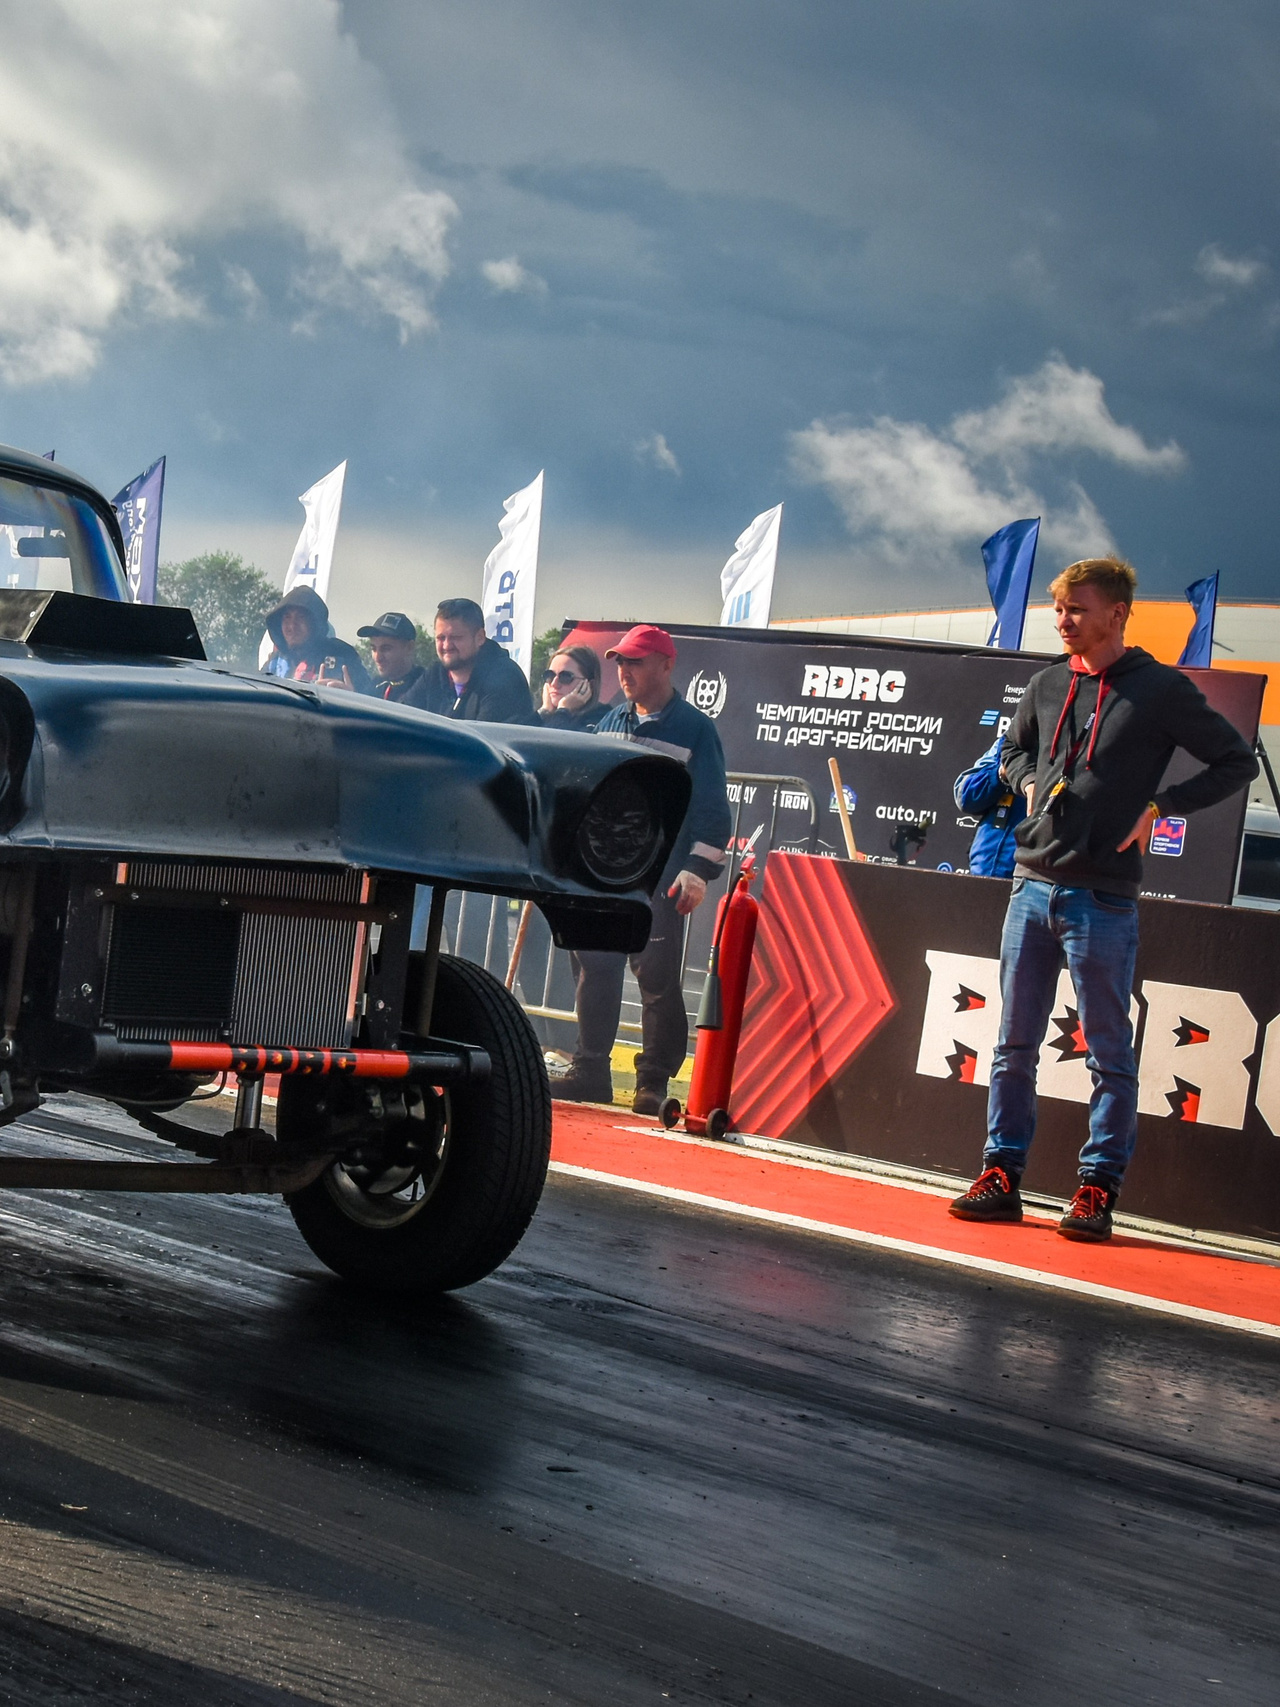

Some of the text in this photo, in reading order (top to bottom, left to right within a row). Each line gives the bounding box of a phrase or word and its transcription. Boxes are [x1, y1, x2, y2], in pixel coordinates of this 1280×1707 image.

[801, 664, 907, 703] RDRC
[756, 702, 943, 735] ЧЕМПИОНАТ РОССИИ
[756, 724, 934, 756] ПО ДРЭГ-РЕЙСИНГУ
[916, 949, 1280, 1138] RDR
